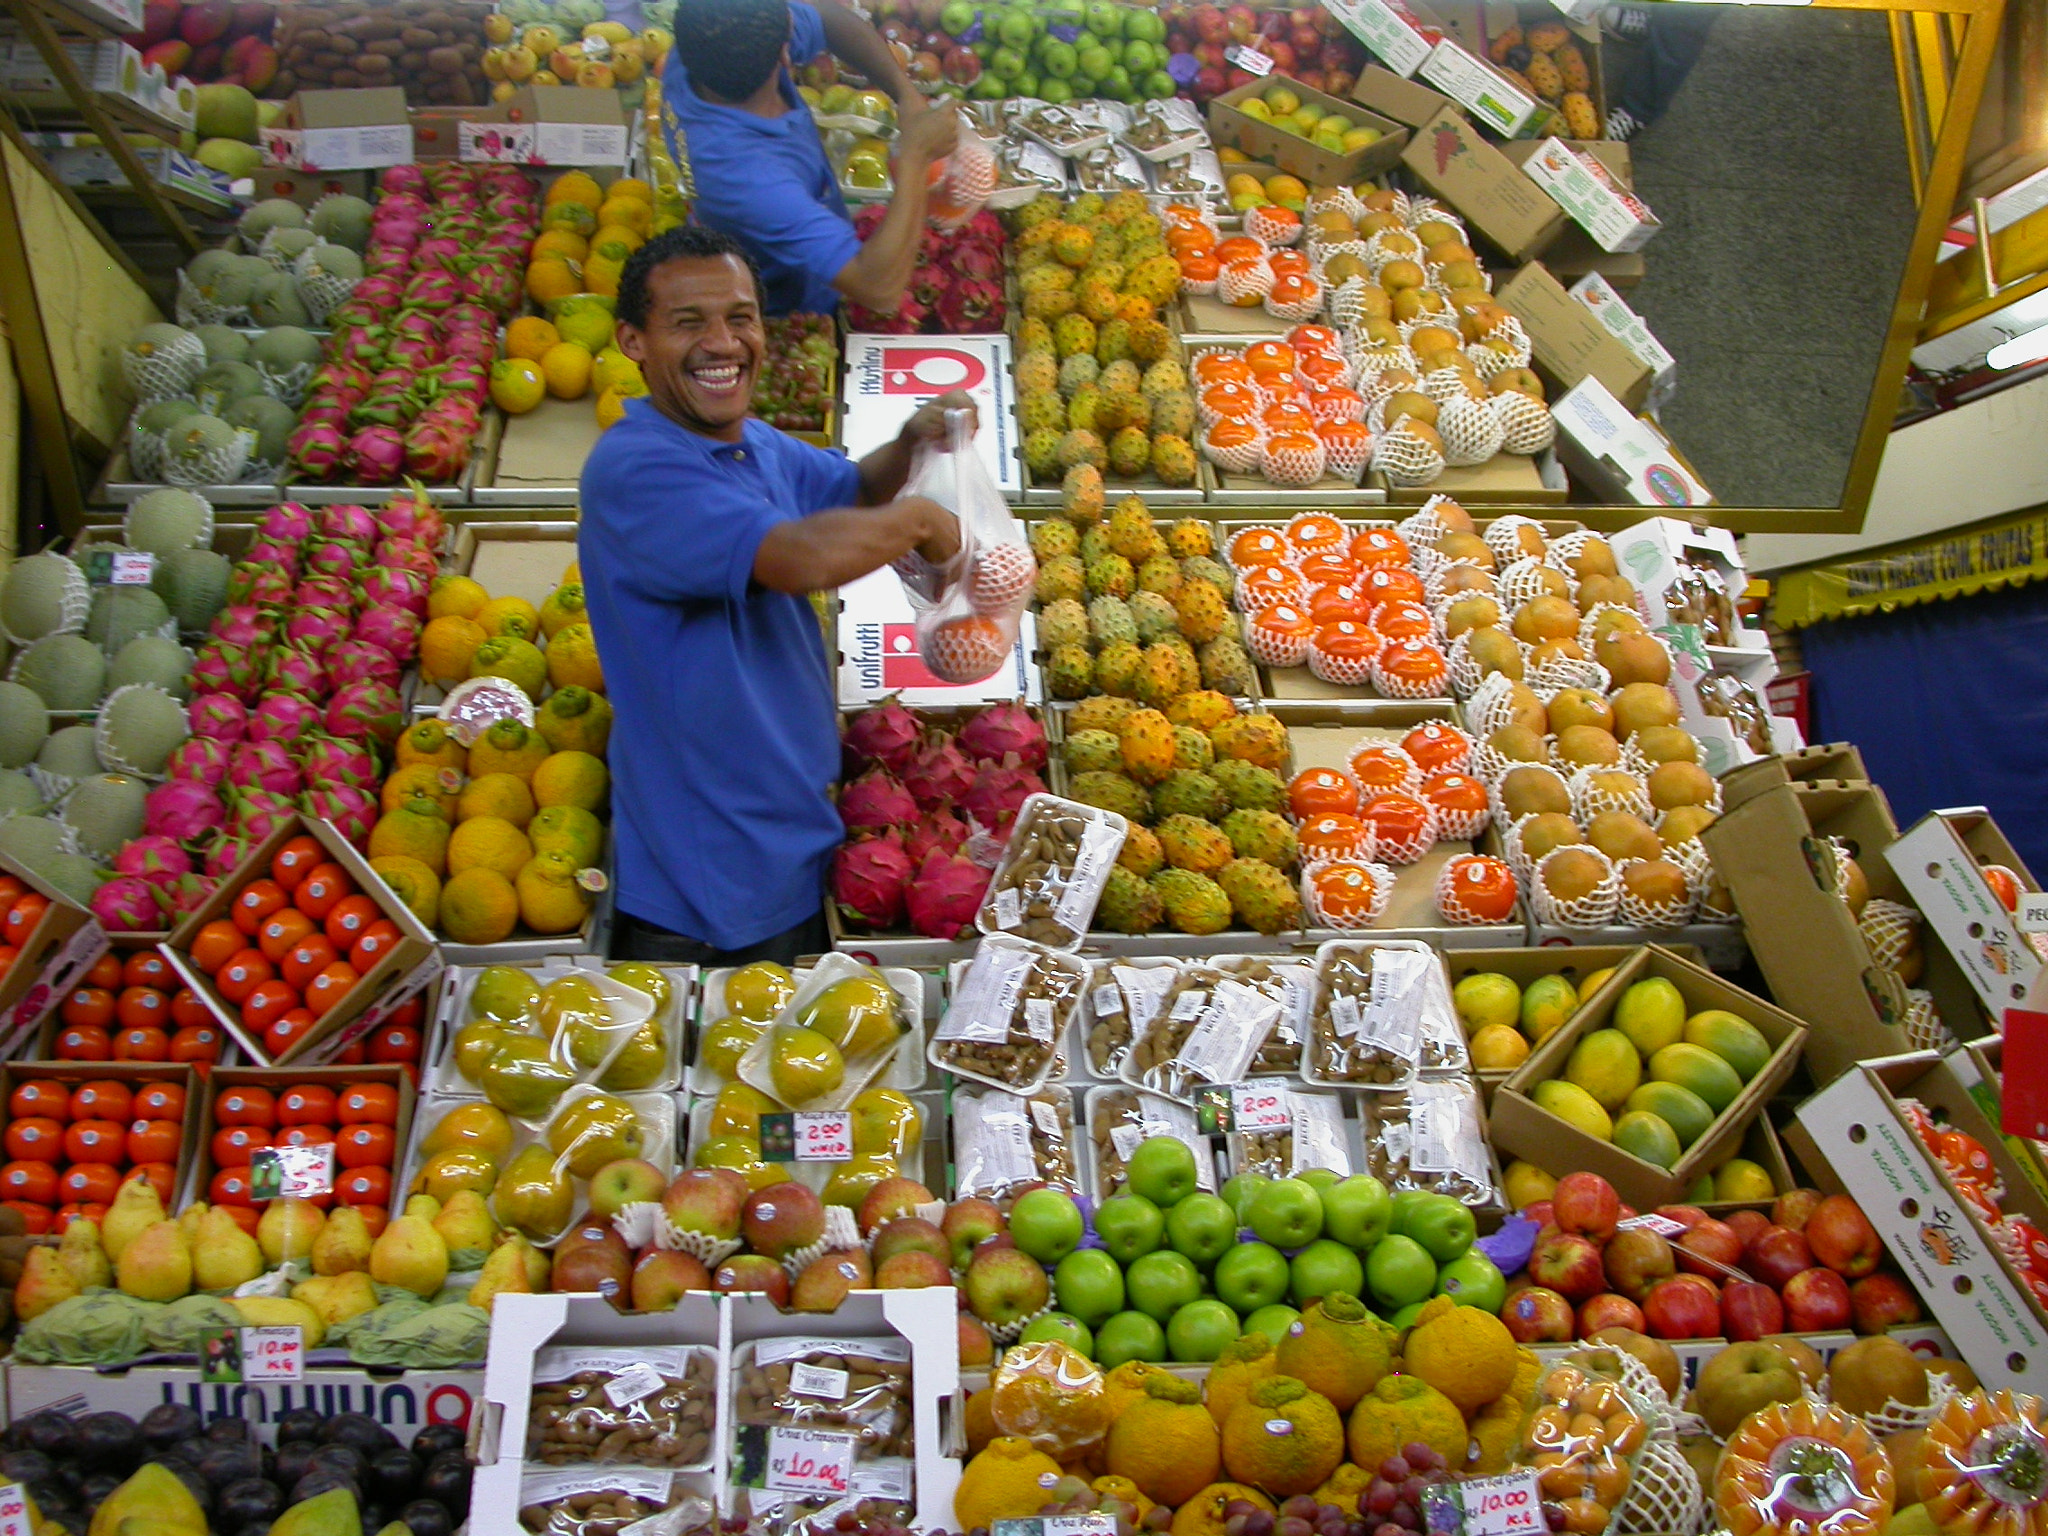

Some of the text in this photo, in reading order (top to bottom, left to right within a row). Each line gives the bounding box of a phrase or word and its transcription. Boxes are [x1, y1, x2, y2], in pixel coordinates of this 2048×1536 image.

[851, 623, 881, 690] unifrutti
[1876, 1123, 1932, 1195] HIGH QUALITY
[1981, 1273, 2040, 1348] HIGH QUALITY
[785, 1451, 839, 1479] 10.00
[1480, 1489, 1528, 1515] 10.00
